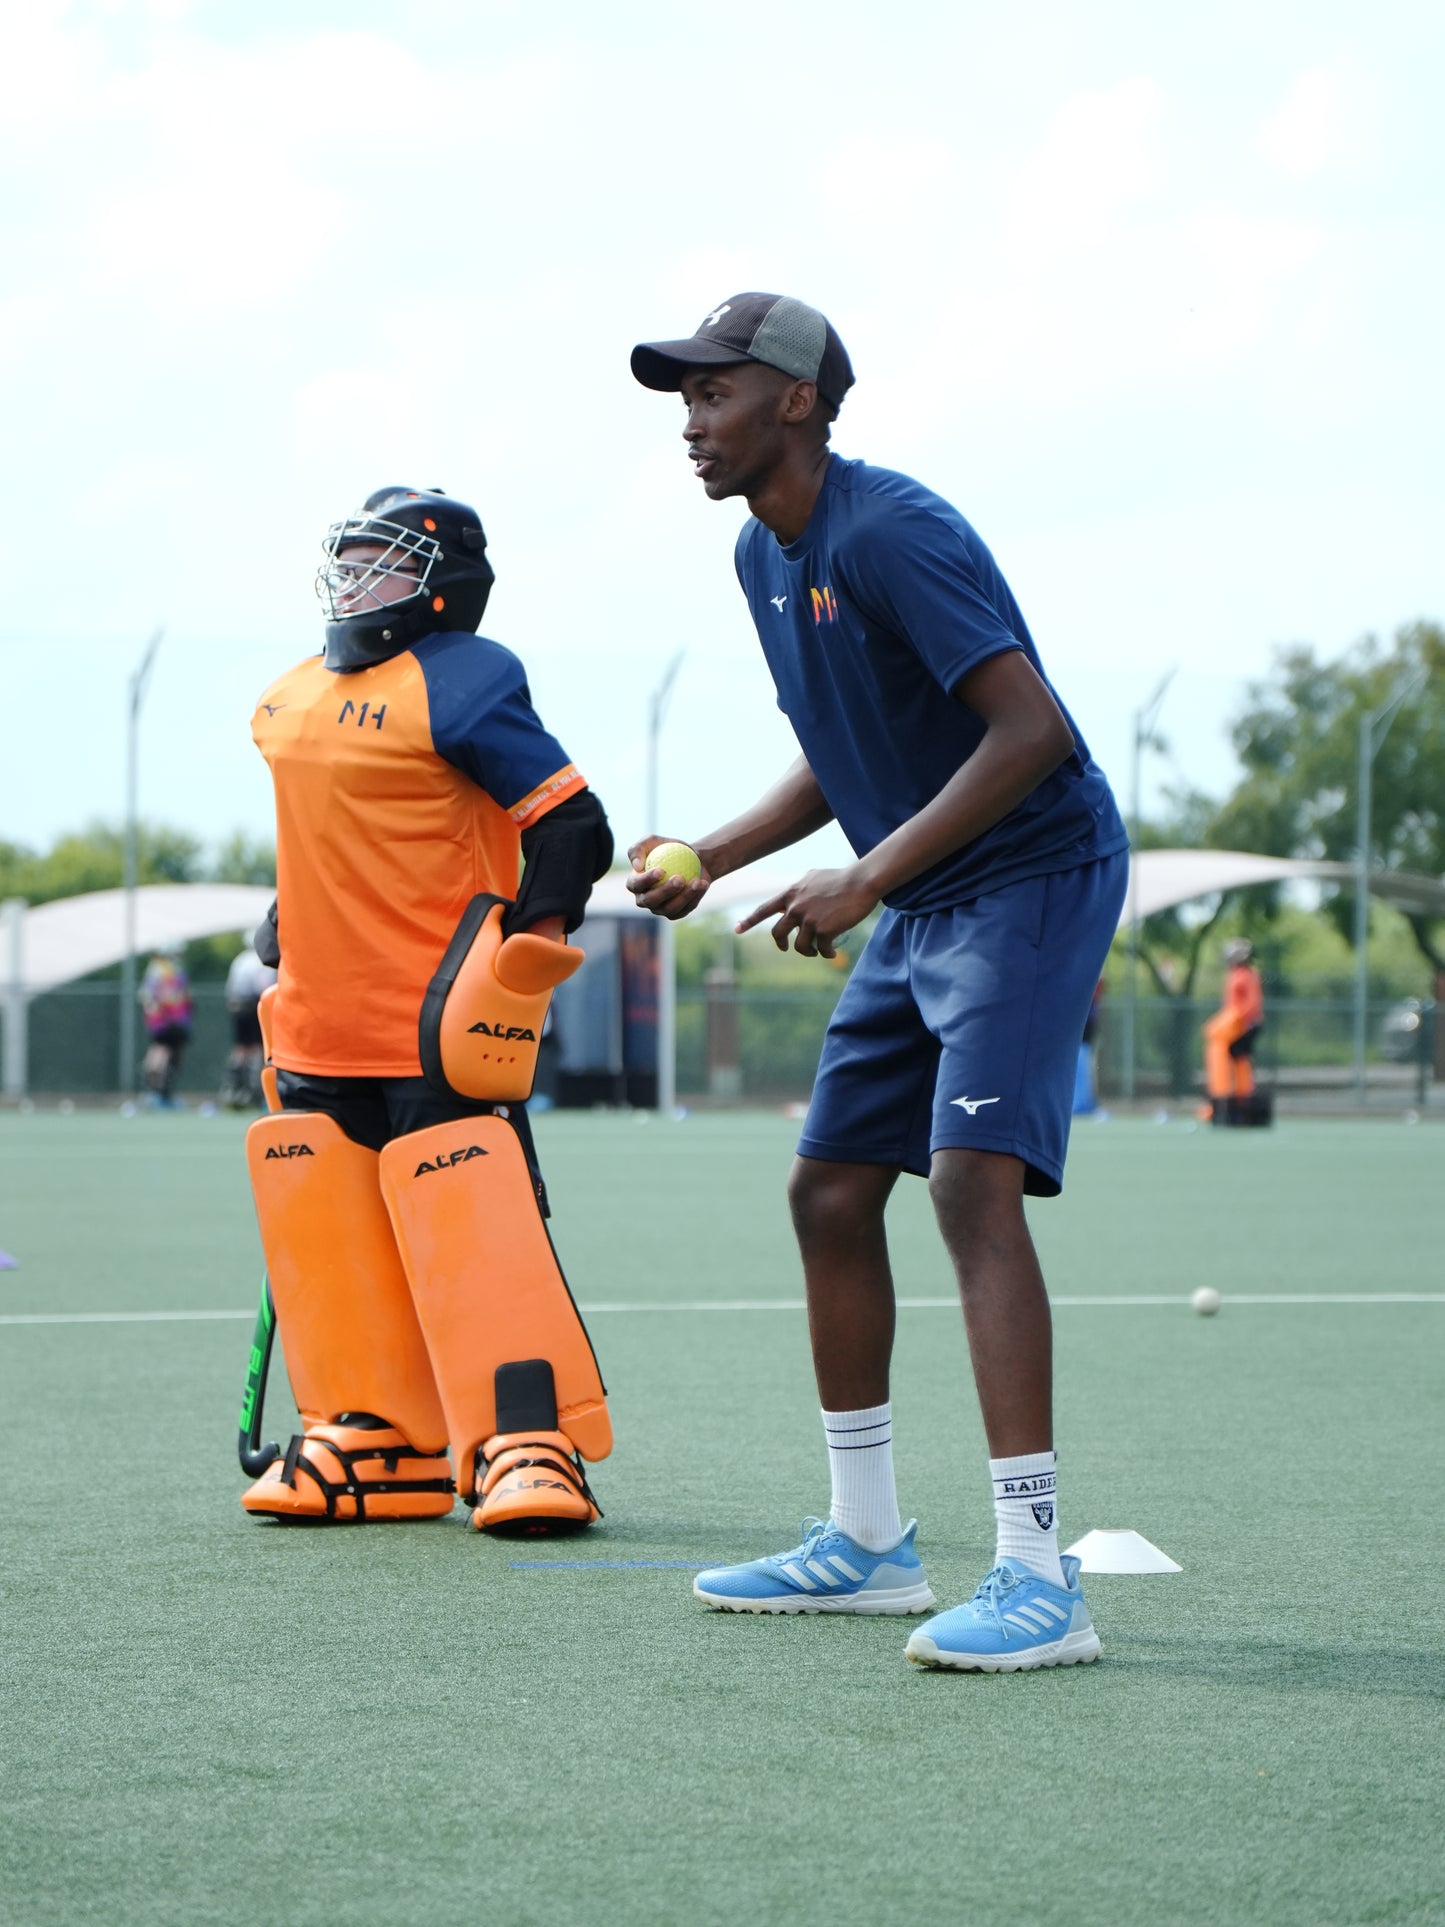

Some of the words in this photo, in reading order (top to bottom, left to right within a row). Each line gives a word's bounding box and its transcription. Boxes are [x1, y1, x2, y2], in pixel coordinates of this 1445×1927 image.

[338, 699, 387, 730] MH
[467, 1022, 536, 1042] ALFA
[265, 1143, 315, 1160] ALFA
[414, 1145, 489, 1178] ALFA
[240, 1344, 261, 1433] ELITE
[494, 1479, 574, 1502] ALFA
